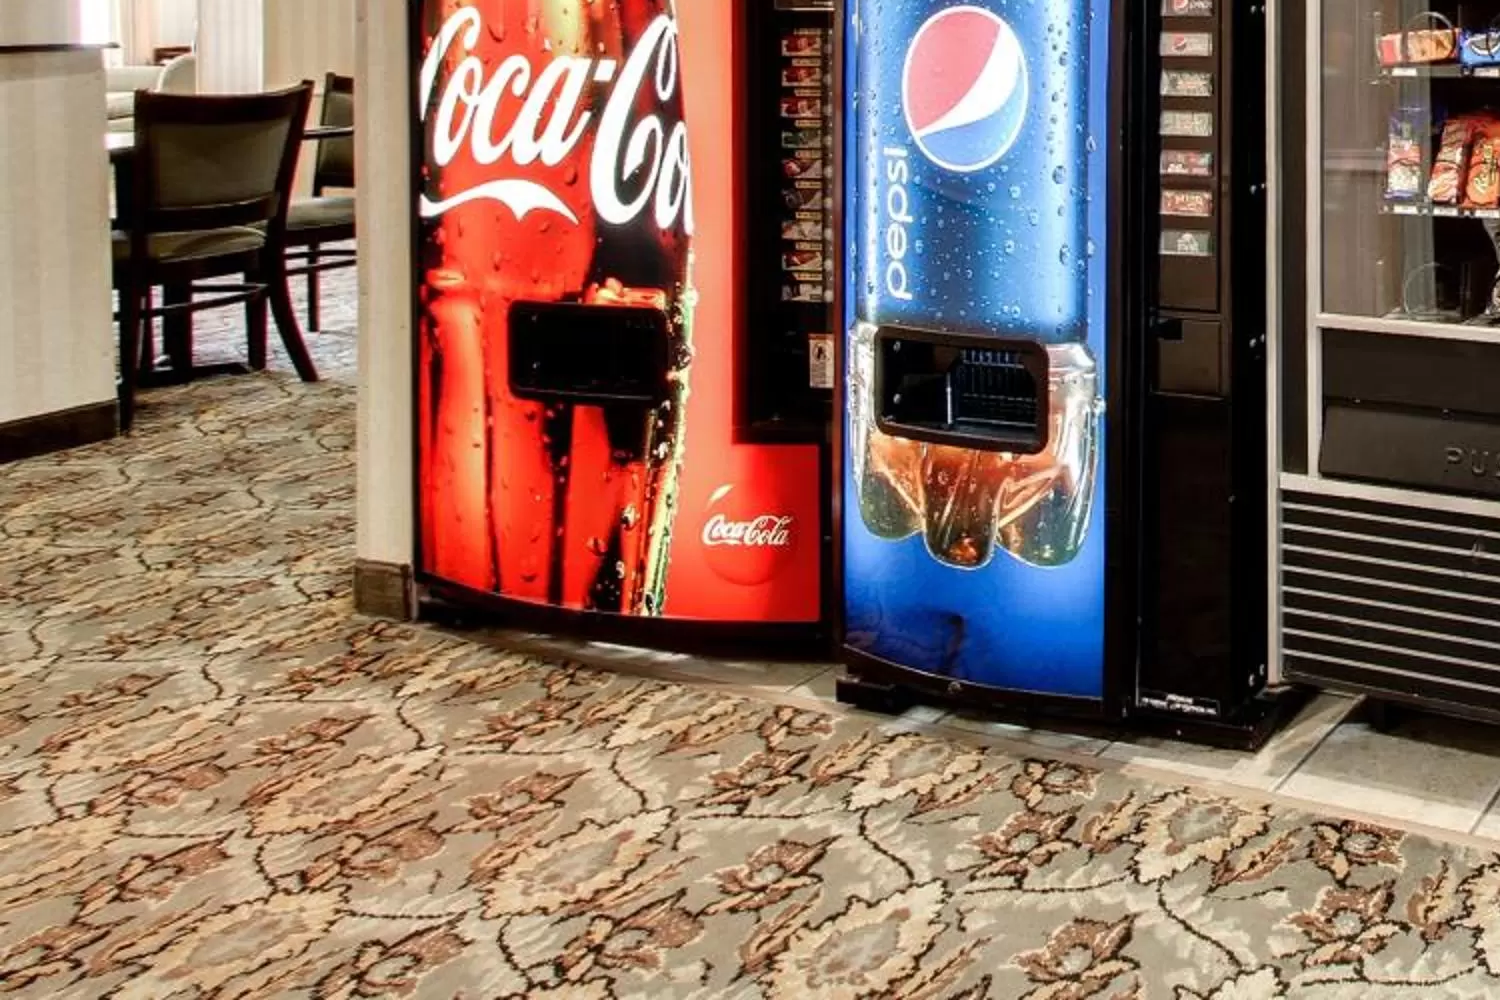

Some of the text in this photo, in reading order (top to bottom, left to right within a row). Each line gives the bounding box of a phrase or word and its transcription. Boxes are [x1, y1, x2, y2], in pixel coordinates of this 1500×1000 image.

[420, 6, 694, 236] Coca-Co
[884, 147, 913, 300] pepsi
[702, 513, 792, 546] Coca-Cola
